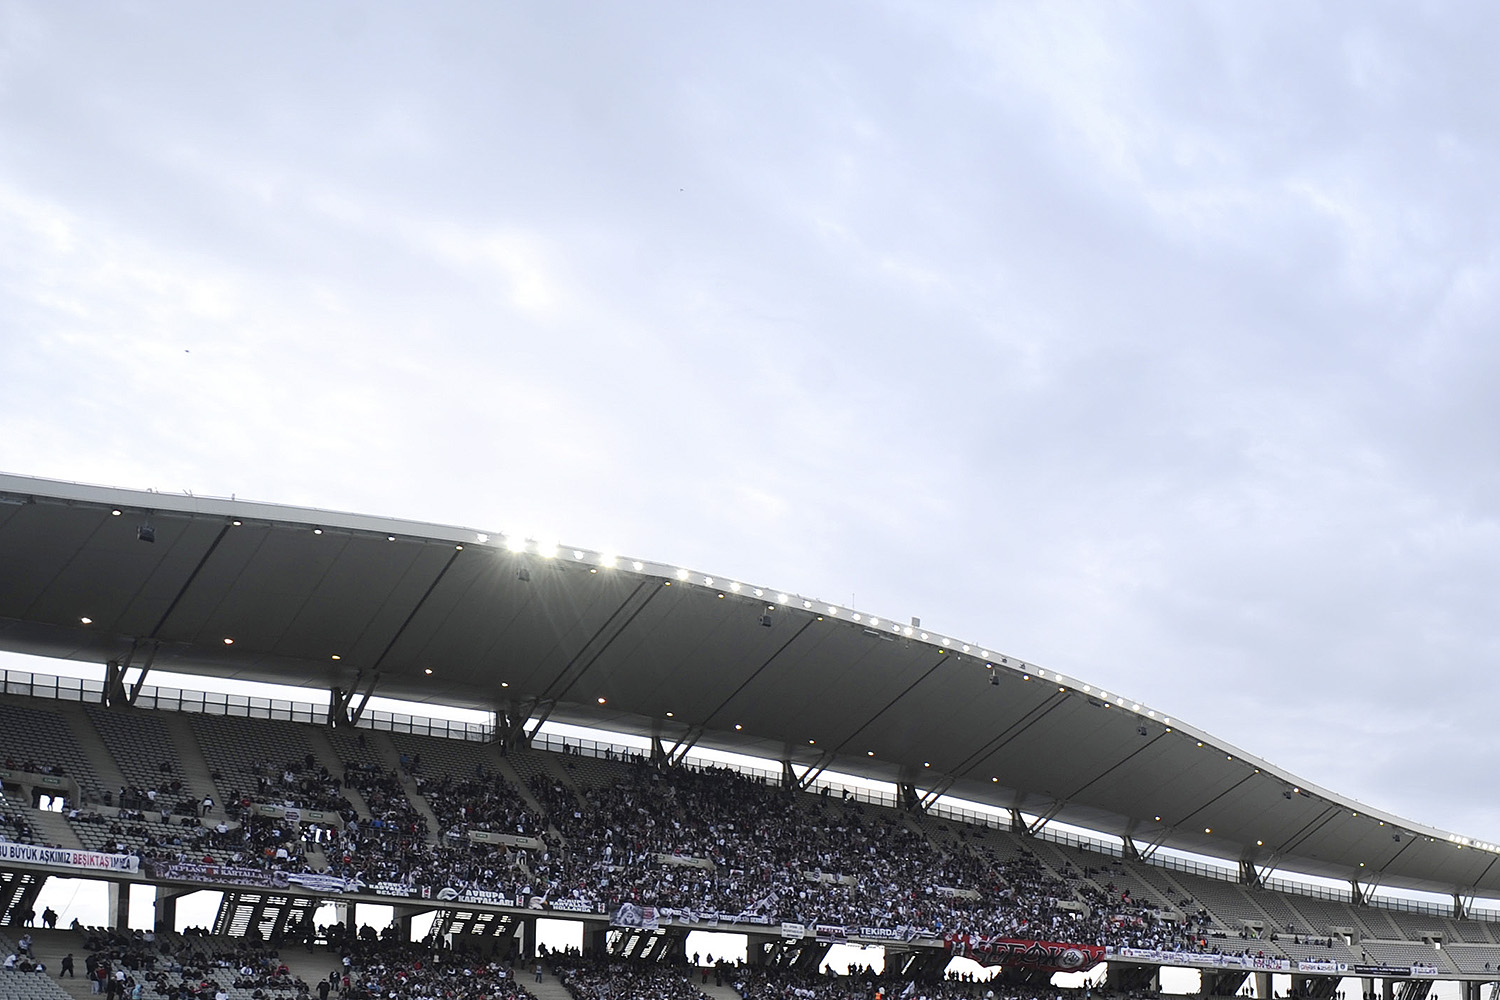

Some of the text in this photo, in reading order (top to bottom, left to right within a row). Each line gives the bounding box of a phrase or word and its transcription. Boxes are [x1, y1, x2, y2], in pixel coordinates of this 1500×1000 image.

[10, 845, 37, 861] BÜYÜK
[40, 850, 71, 865] AŞKIMIZ
[465, 889, 505, 899] AVRUPA
[458, 895, 514, 907] KARTALLARI
